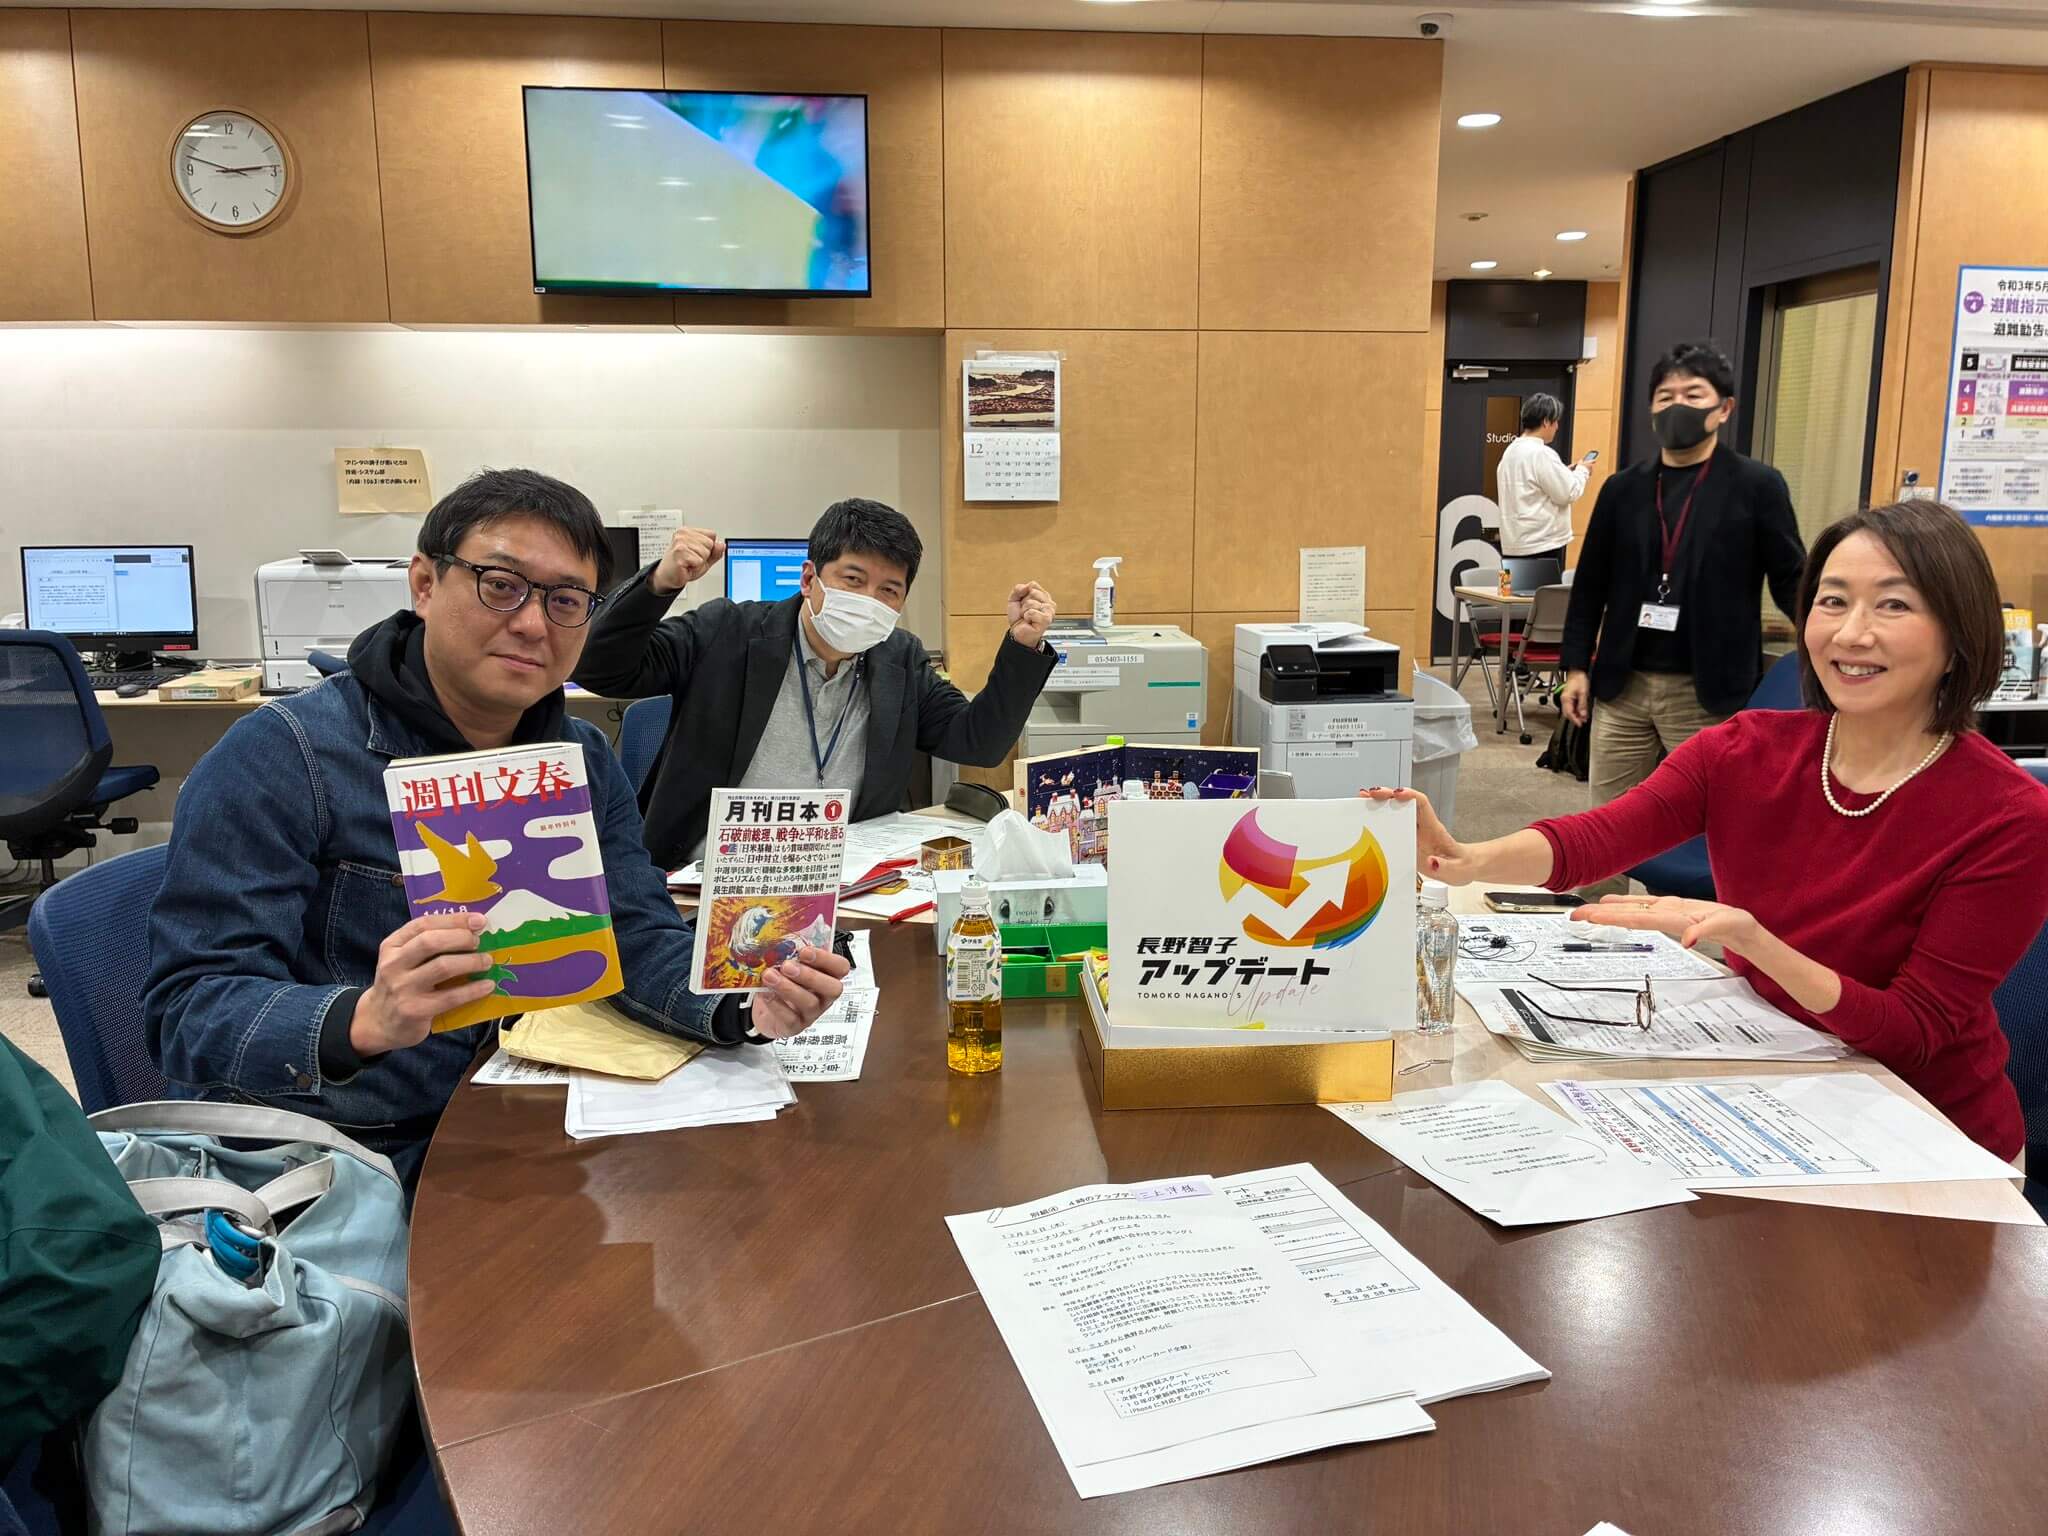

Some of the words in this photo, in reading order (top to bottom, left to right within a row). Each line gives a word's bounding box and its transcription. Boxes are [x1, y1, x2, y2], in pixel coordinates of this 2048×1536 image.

[225, 122, 233, 135] 12
[186, 163, 194, 176] 9
[270, 165, 278, 177] 3
[232, 205, 239, 218] 6
[1966, 358, 1974, 368] 5
[1964, 384, 1970, 395] 4
[1961, 417, 1967, 426] 2
[970, 443, 984, 454] 12
[401, 760, 575, 820] 週刊文春
[725, 801, 819, 822] 月刊日本
[718, 825, 844, 843] 石破前総理、戦争と平和を語る
[1137, 937, 1238, 954] 長野智子
[1138, 956, 1330, 986] アップデート
[1227, 975, 1322, 1023] Update
